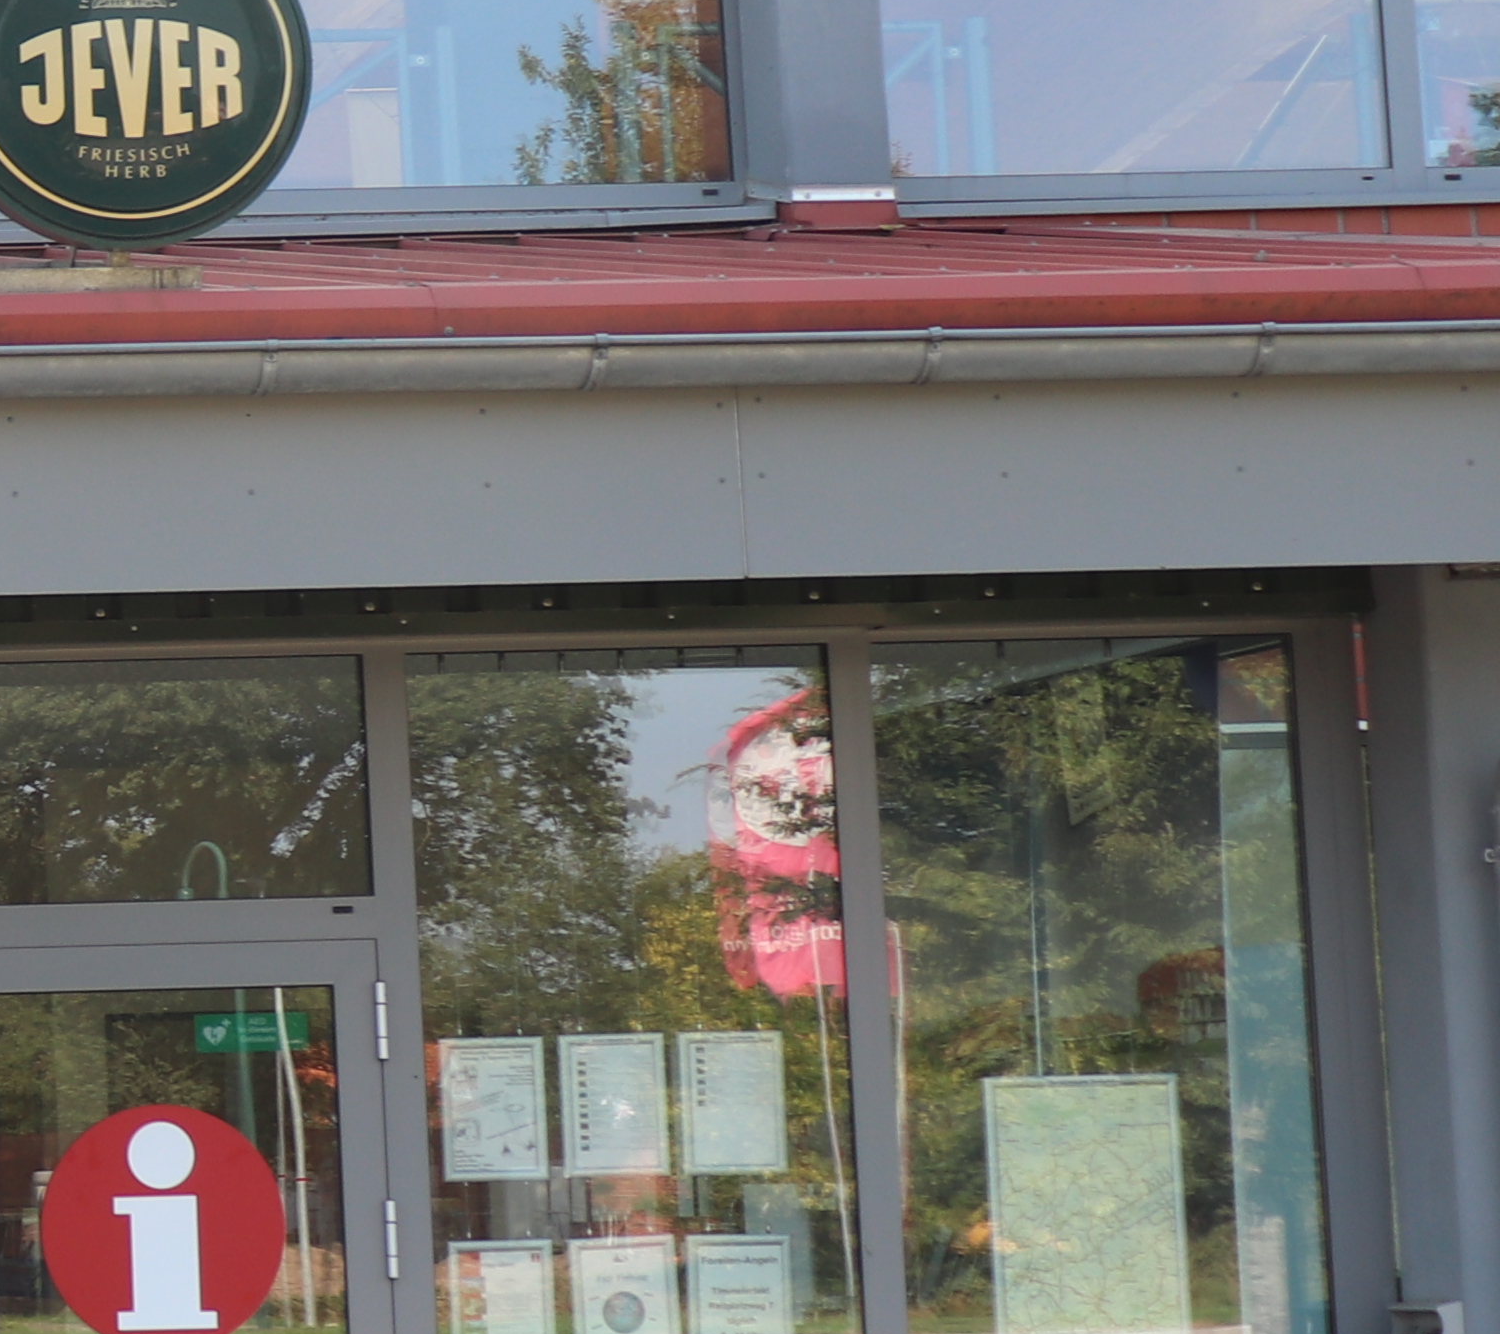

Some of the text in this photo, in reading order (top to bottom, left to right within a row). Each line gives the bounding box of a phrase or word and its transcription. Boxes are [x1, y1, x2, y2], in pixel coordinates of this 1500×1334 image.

[19, 18, 244, 139] JEVER
[78, 143, 191, 163] FRIESISCH
[105, 163, 168, 180] HERB
